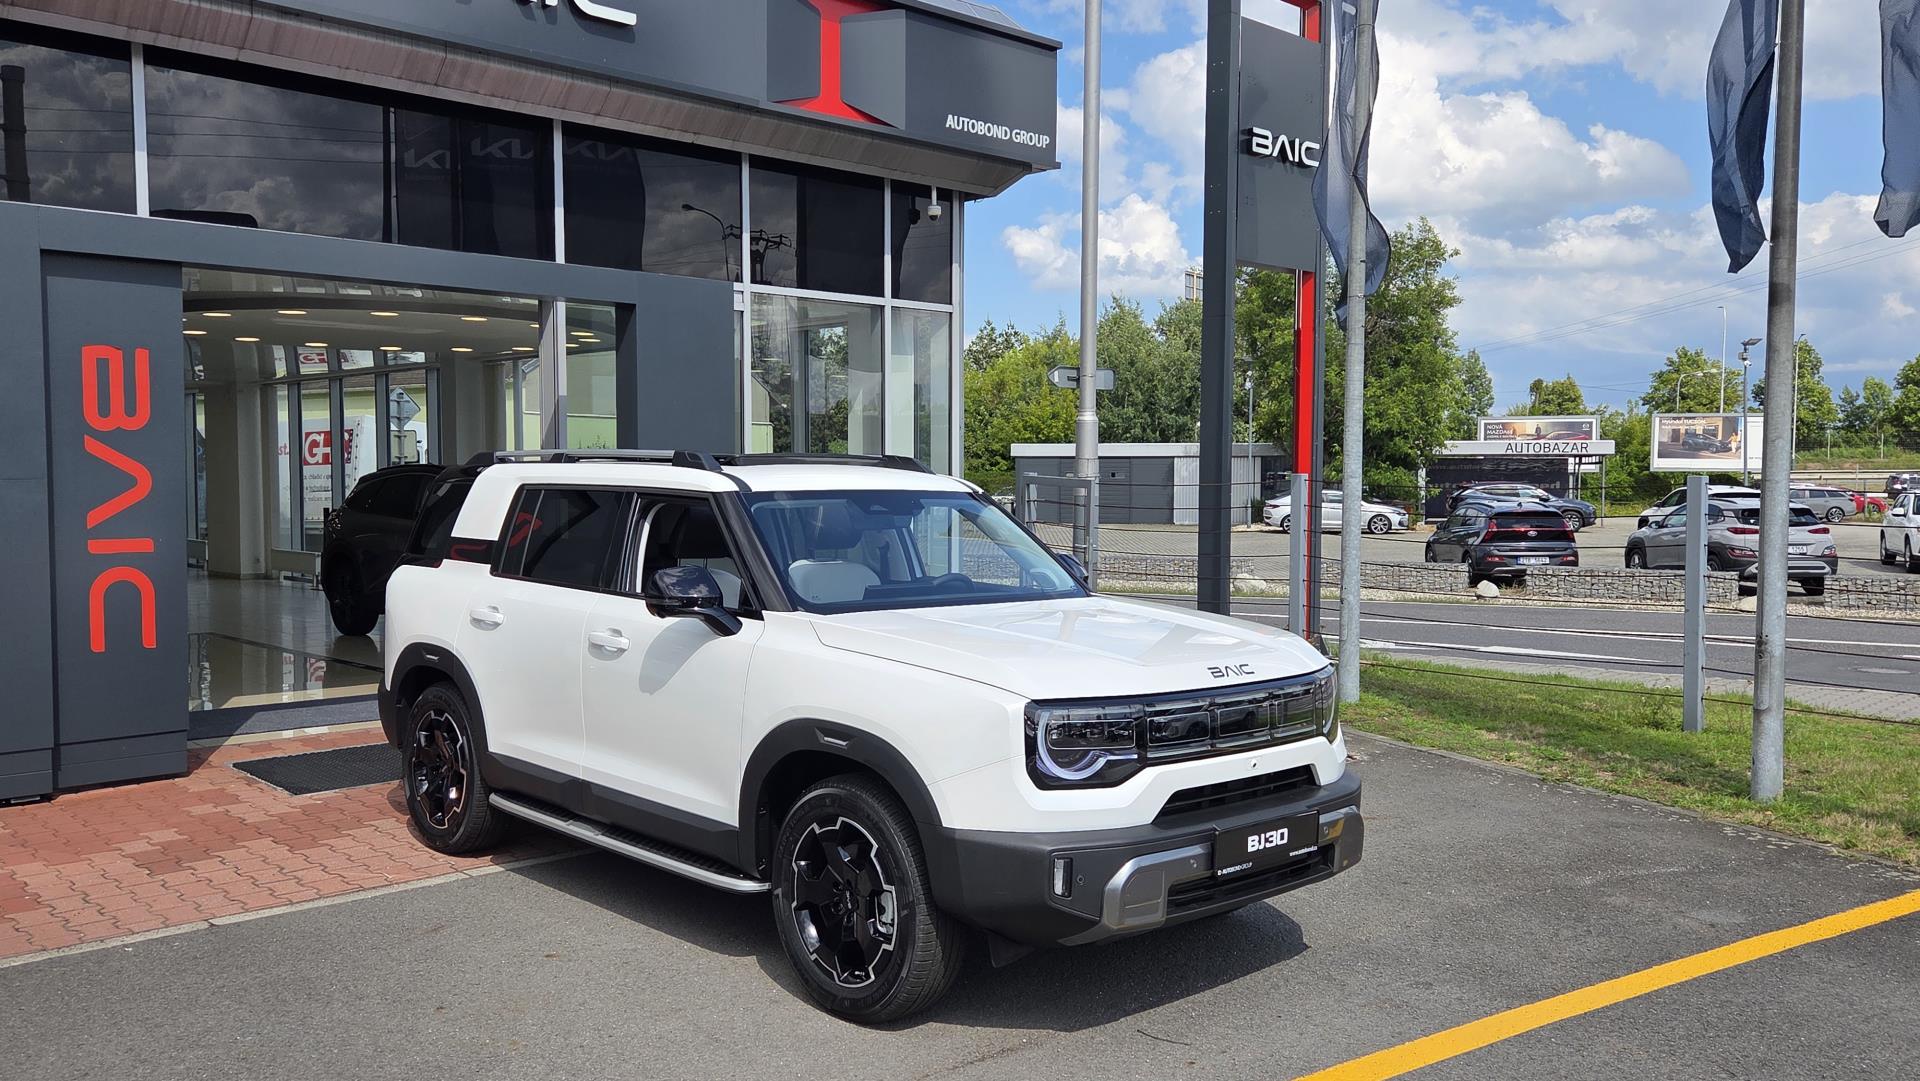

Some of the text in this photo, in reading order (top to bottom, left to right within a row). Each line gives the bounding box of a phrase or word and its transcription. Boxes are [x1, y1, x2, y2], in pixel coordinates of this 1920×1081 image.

[946, 114, 1050, 148] AUTOBOND GROUP
[1251, 127, 1320, 167] BAIC
[1505, 442, 1589, 453] AUTOBAZAR
[81, 345, 157, 653] BAIC
[1207, 663, 1256, 679] BAIC
[1247, 827, 1289, 853] BJ30
